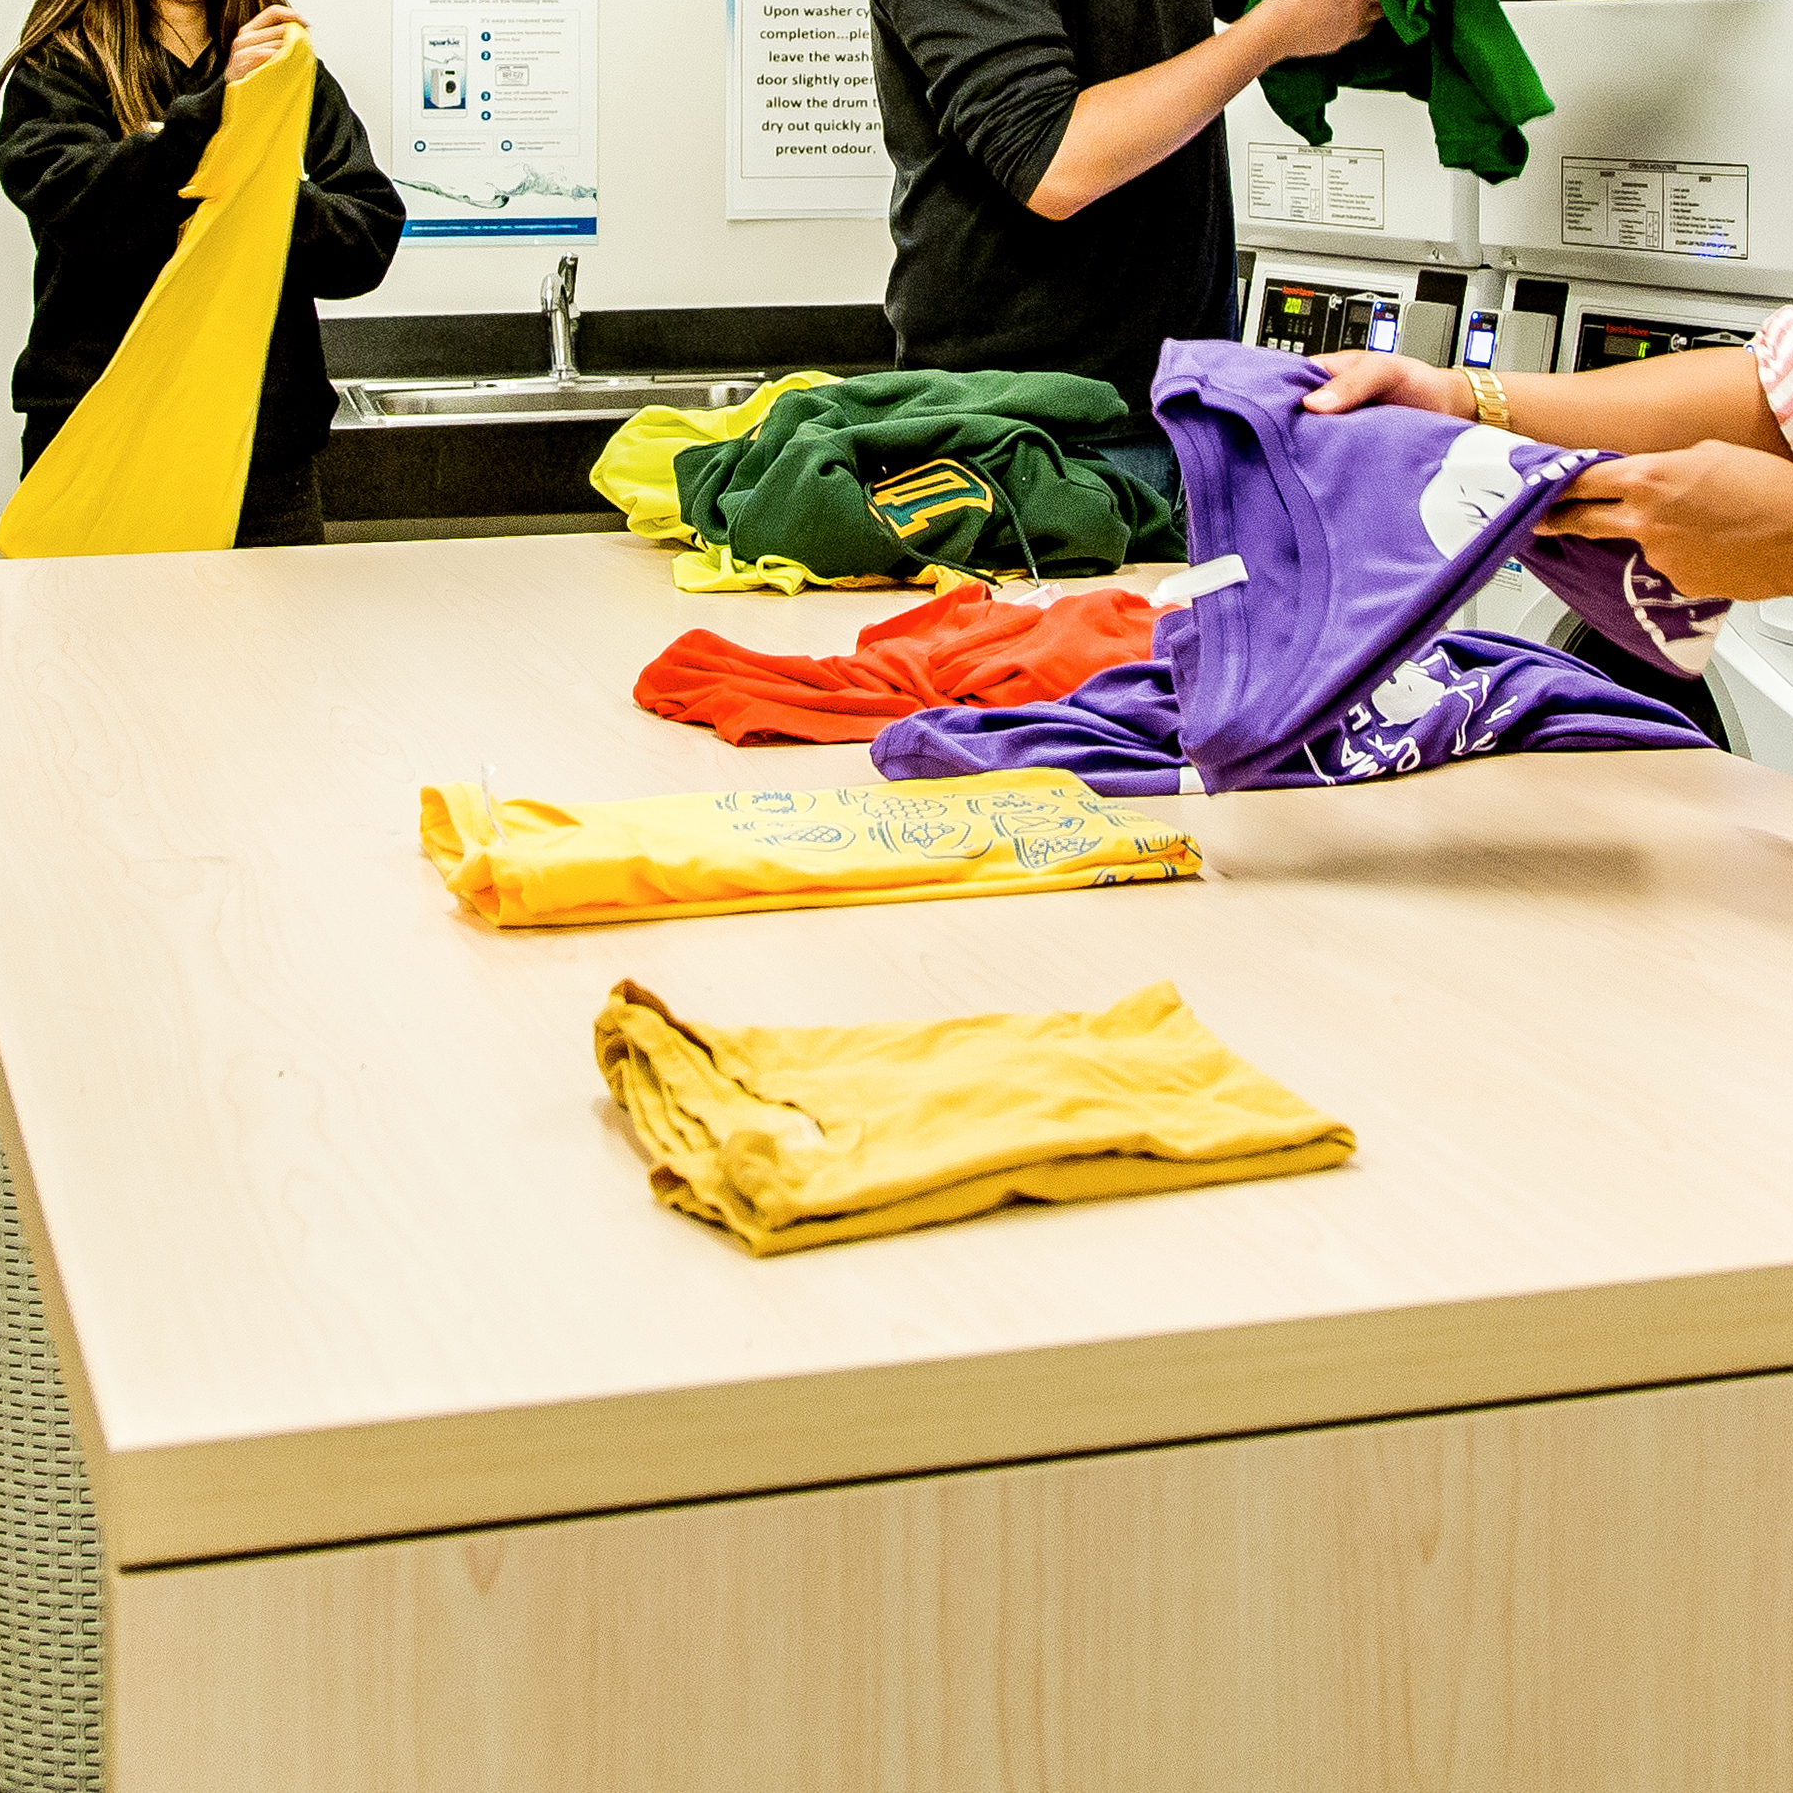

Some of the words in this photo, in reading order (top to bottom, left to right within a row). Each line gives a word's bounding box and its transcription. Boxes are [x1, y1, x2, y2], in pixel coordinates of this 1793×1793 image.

[763, 5, 799, 19] Upon
[803, 5, 851, 17] washer
[768, 51, 804, 63] leave
[809, 51, 830, 63] the
[756, 74, 788, 86] door
[792, 74, 840, 88] slightly
[766, 97, 803, 108] allow
[806, 97, 828, 108] the
[832, 97, 868, 108] drum
[761, 120, 784, 134] dry
[787, 121, 810, 132] out
[814, 120, 862, 134] quickly
[776, 144, 827, 157] prevent
[831, 143, 877, 155] odour.
